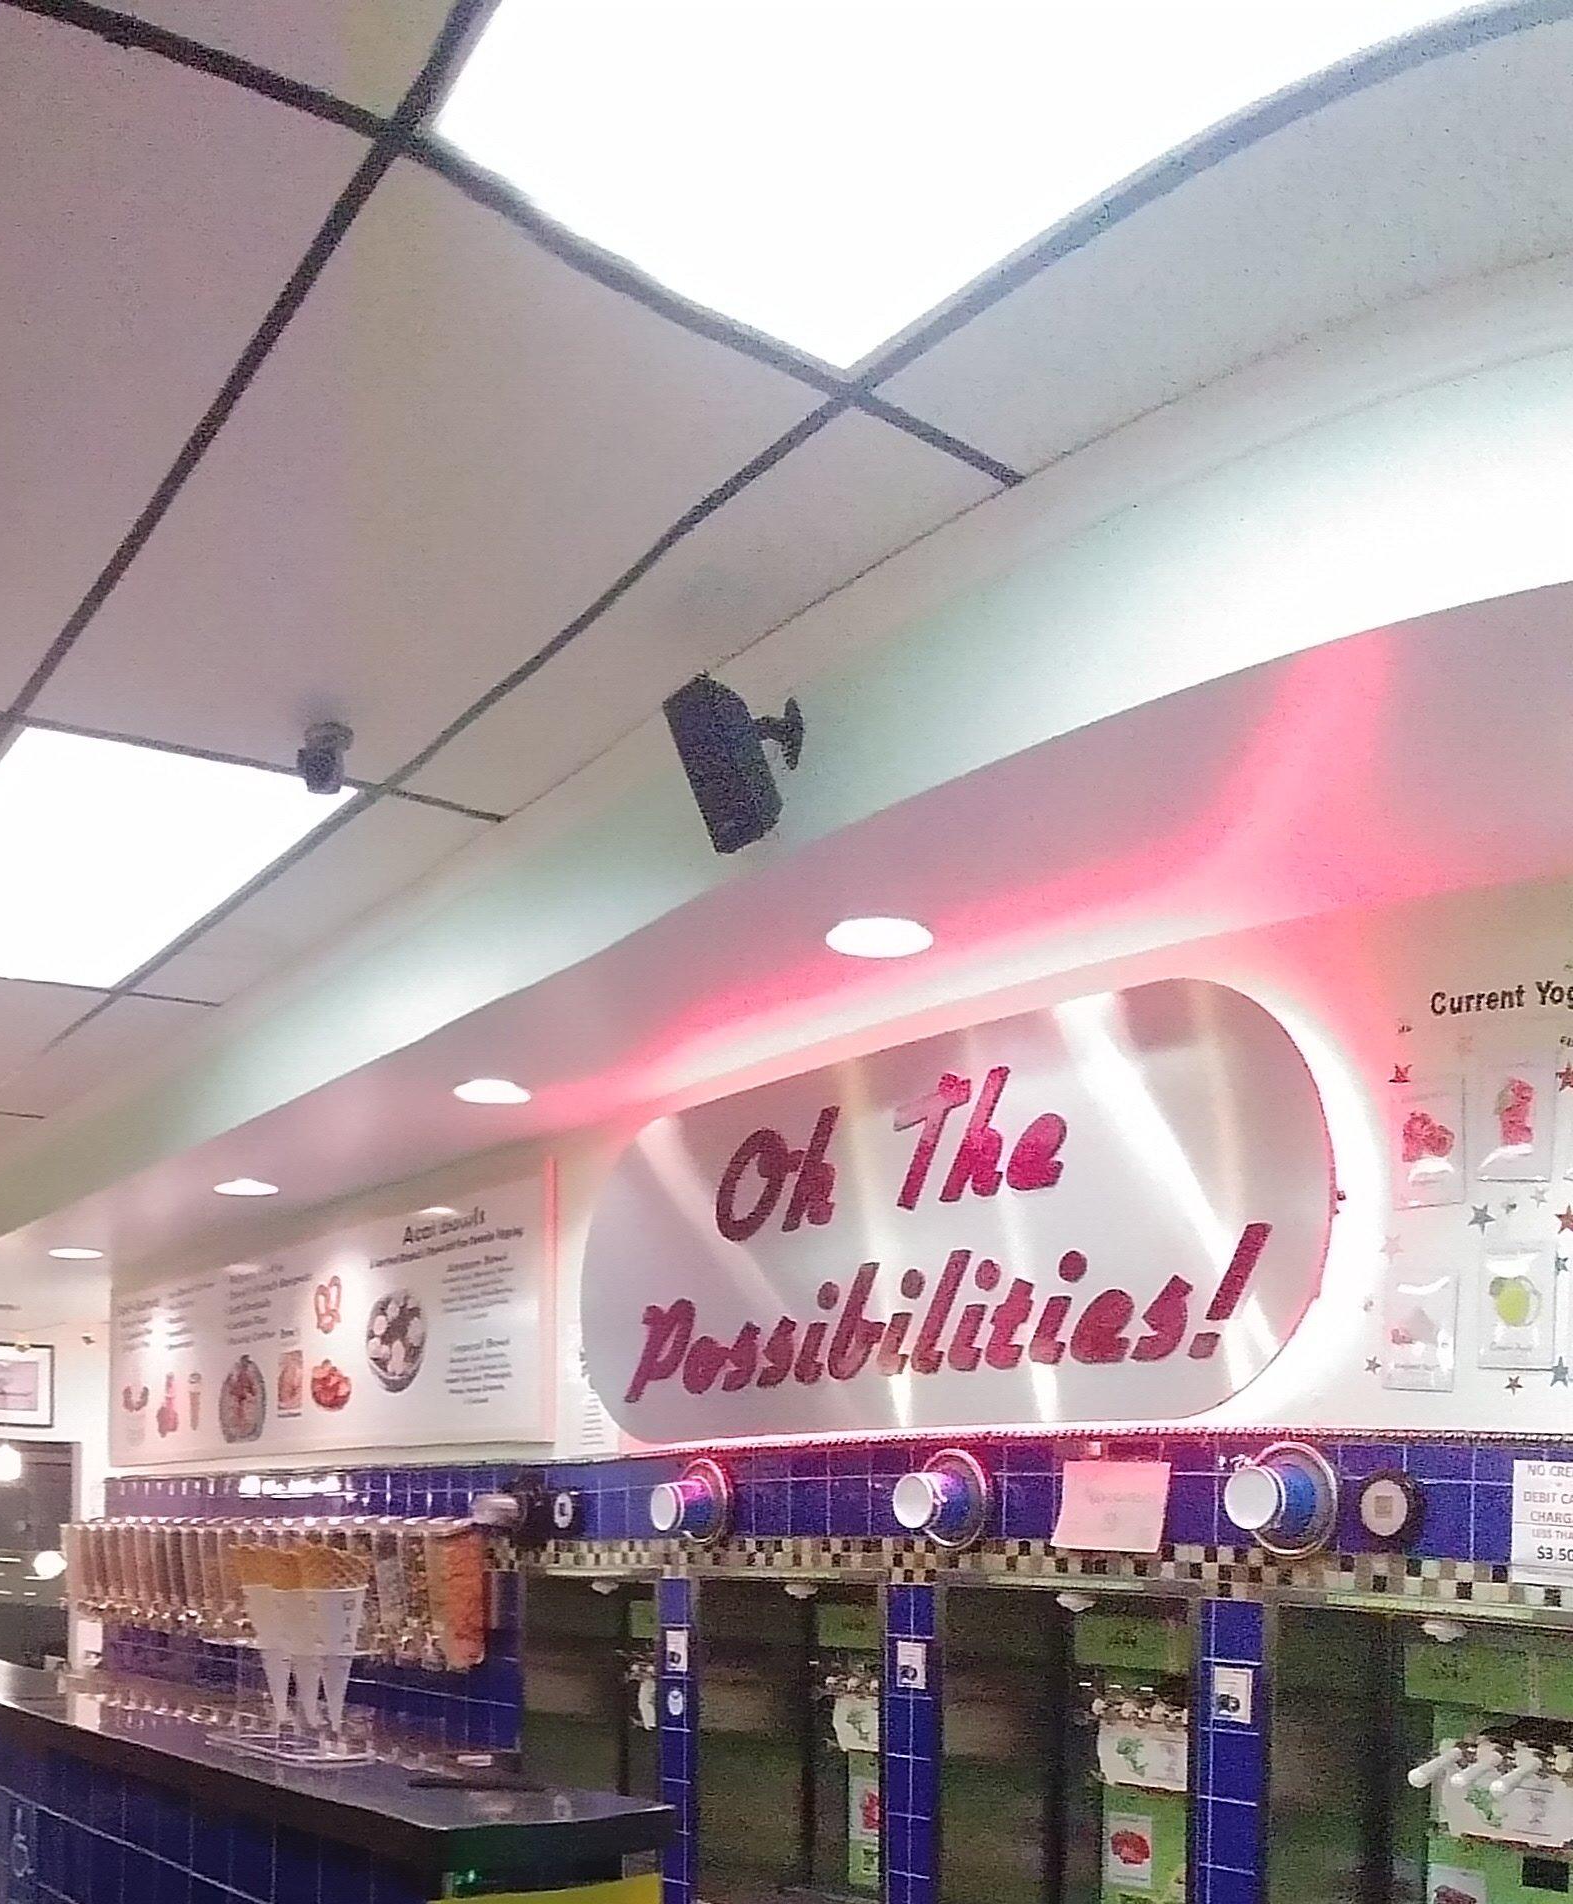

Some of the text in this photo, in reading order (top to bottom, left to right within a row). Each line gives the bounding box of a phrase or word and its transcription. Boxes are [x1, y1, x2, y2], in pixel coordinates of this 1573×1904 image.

[1430, 983, 1526, 1016] Current
[716, 1066, 1067, 1242] Oh The
[624, 1222, 1273, 1402] Possibilities!
[1528, 1464, 1545, 1476] NO
[1523, 1491, 1557, 1503] DEBIT
